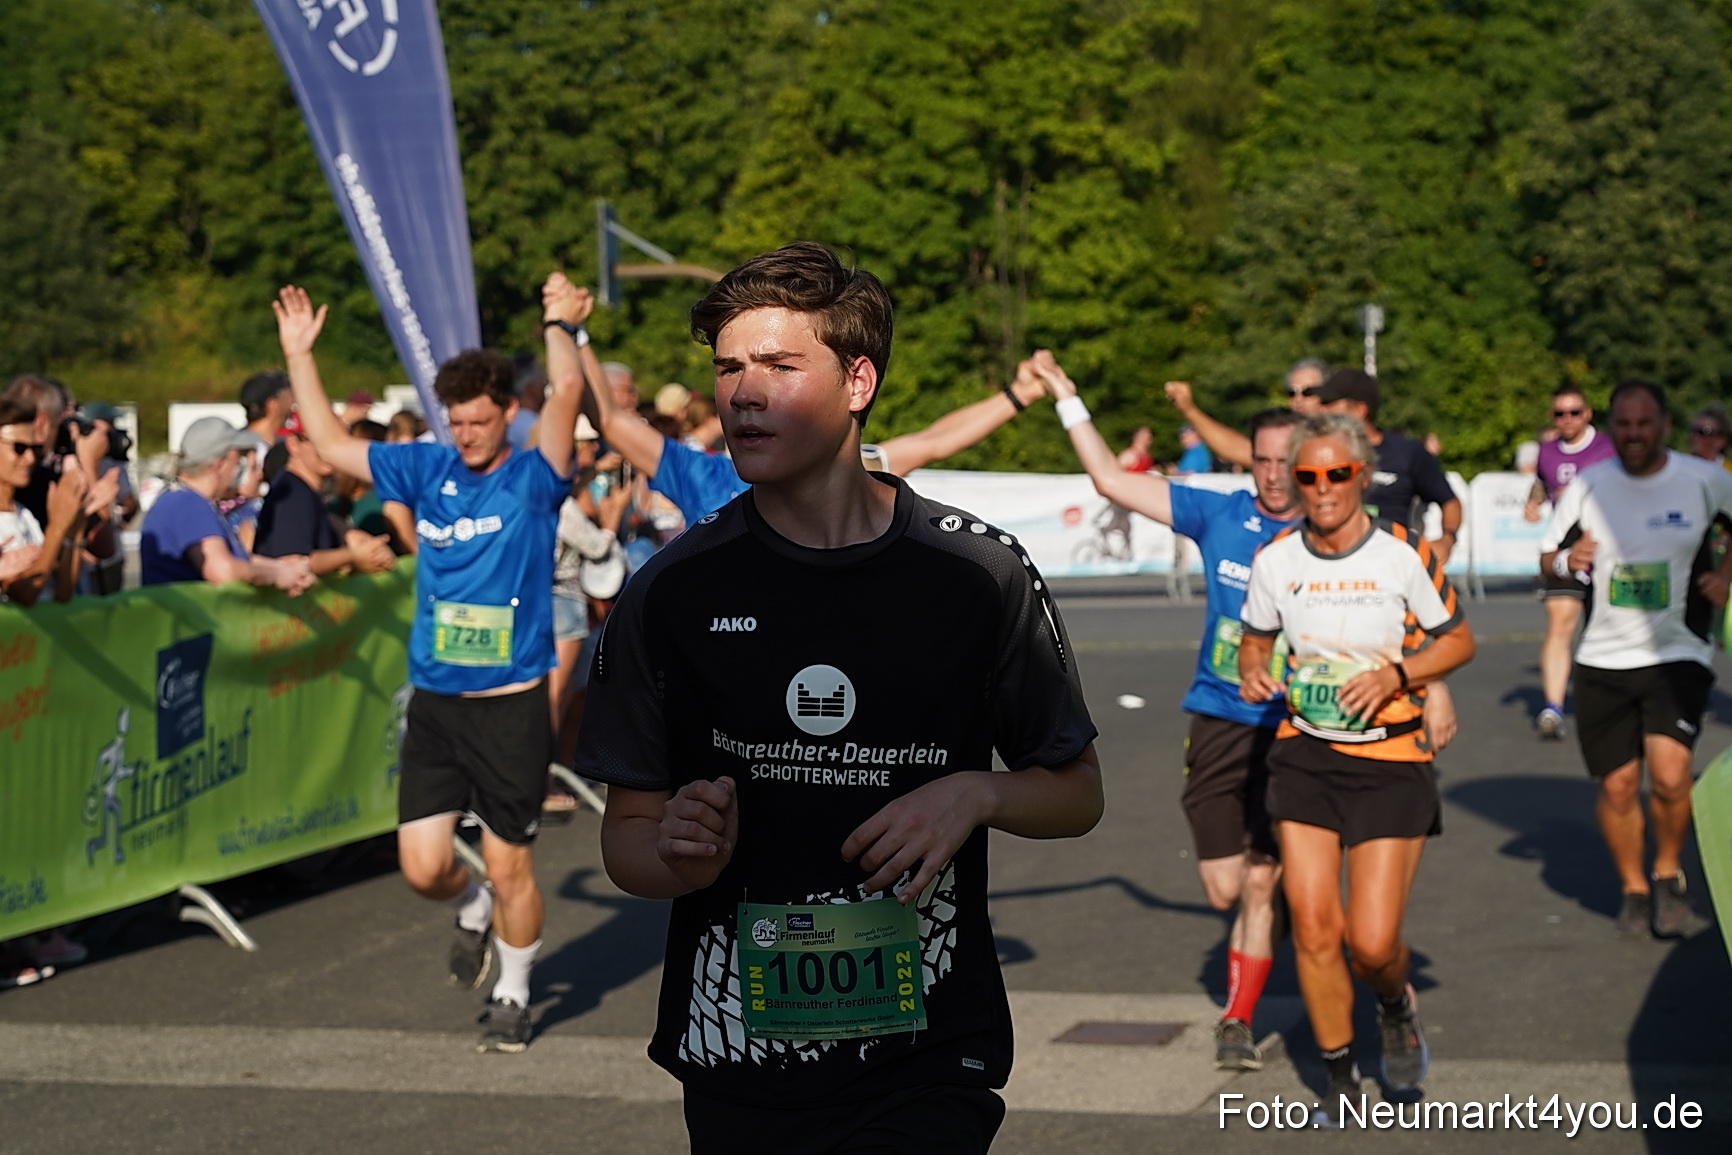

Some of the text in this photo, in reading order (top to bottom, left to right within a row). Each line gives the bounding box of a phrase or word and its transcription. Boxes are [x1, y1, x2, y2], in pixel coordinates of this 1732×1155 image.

[710, 616, 757, 632] JAKO
[452, 626, 492, 645] 728
[712, 727, 948, 766] Bärnreuther+Deuerlein
[750, 763, 890, 787] SCHOTTERWERKE
[780, 928, 836, 941] Firmenlauf
[802, 937, 836, 947] neumarkt
[768, 947, 886, 996] 1001
[895, 950, 916, 1012] 2022
[749, 966, 766, 1011] RUN
[765, 992, 898, 1010] Bärnreuther Ferdinand
[835, 1017, 876, 1026] Schotterwerke
[877, 1014, 896, 1022] GmbH
